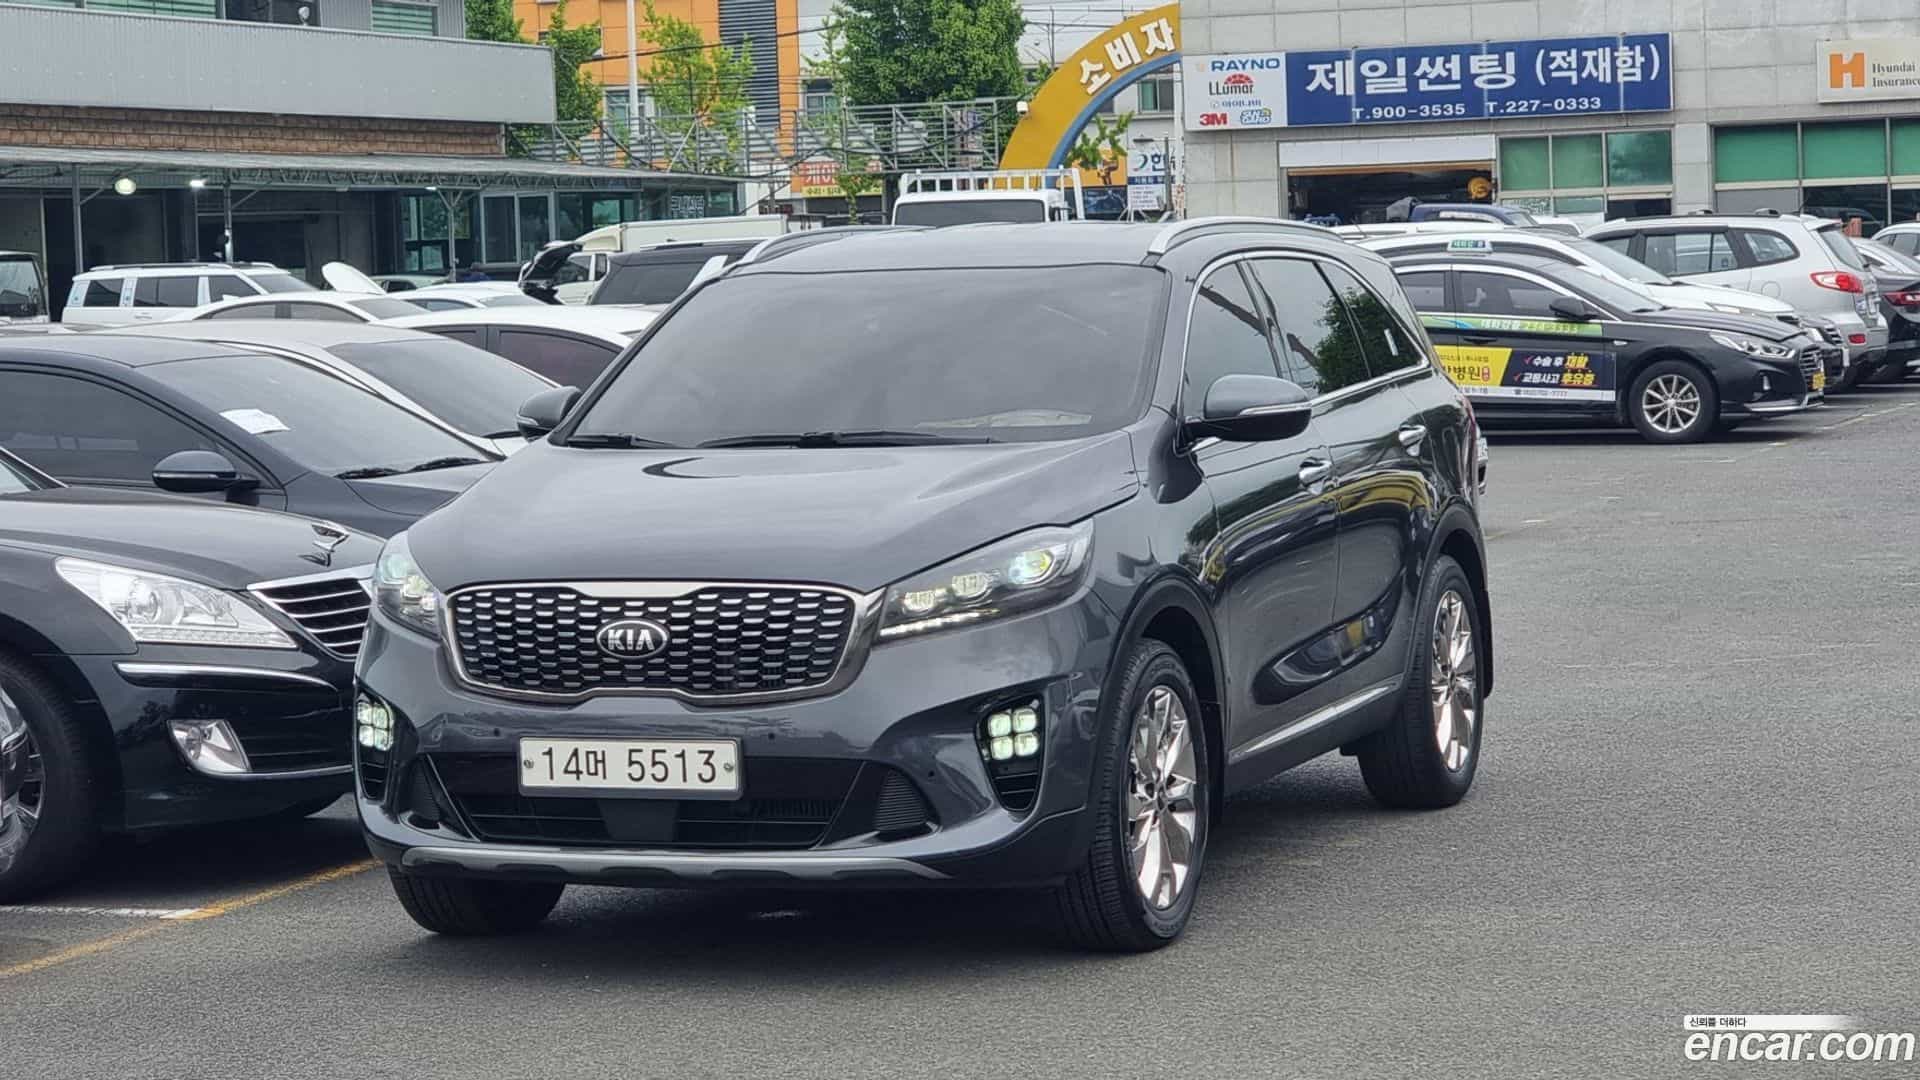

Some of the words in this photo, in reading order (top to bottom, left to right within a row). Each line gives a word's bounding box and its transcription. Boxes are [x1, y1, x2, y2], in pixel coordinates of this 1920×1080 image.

[1079, 17, 1176, 95] 소비자
[1211, 57, 1280, 72] RAYNO
[1305, 50, 1517, 97] 제일썬팅
[1534, 43, 1661, 87] (적재함)
[1872, 61, 1916, 76] Hyundai
[1208, 79, 1254, 96] LLumar
[1200, 112, 1228, 126] 3M
[1352, 102, 1466, 121] T.900-3535
[1485, 96, 1602, 114] T.227-0333
[607, 628, 656, 651] KIA
[542, 747, 607, 781] 14머
[627, 748, 717, 783] 5513
